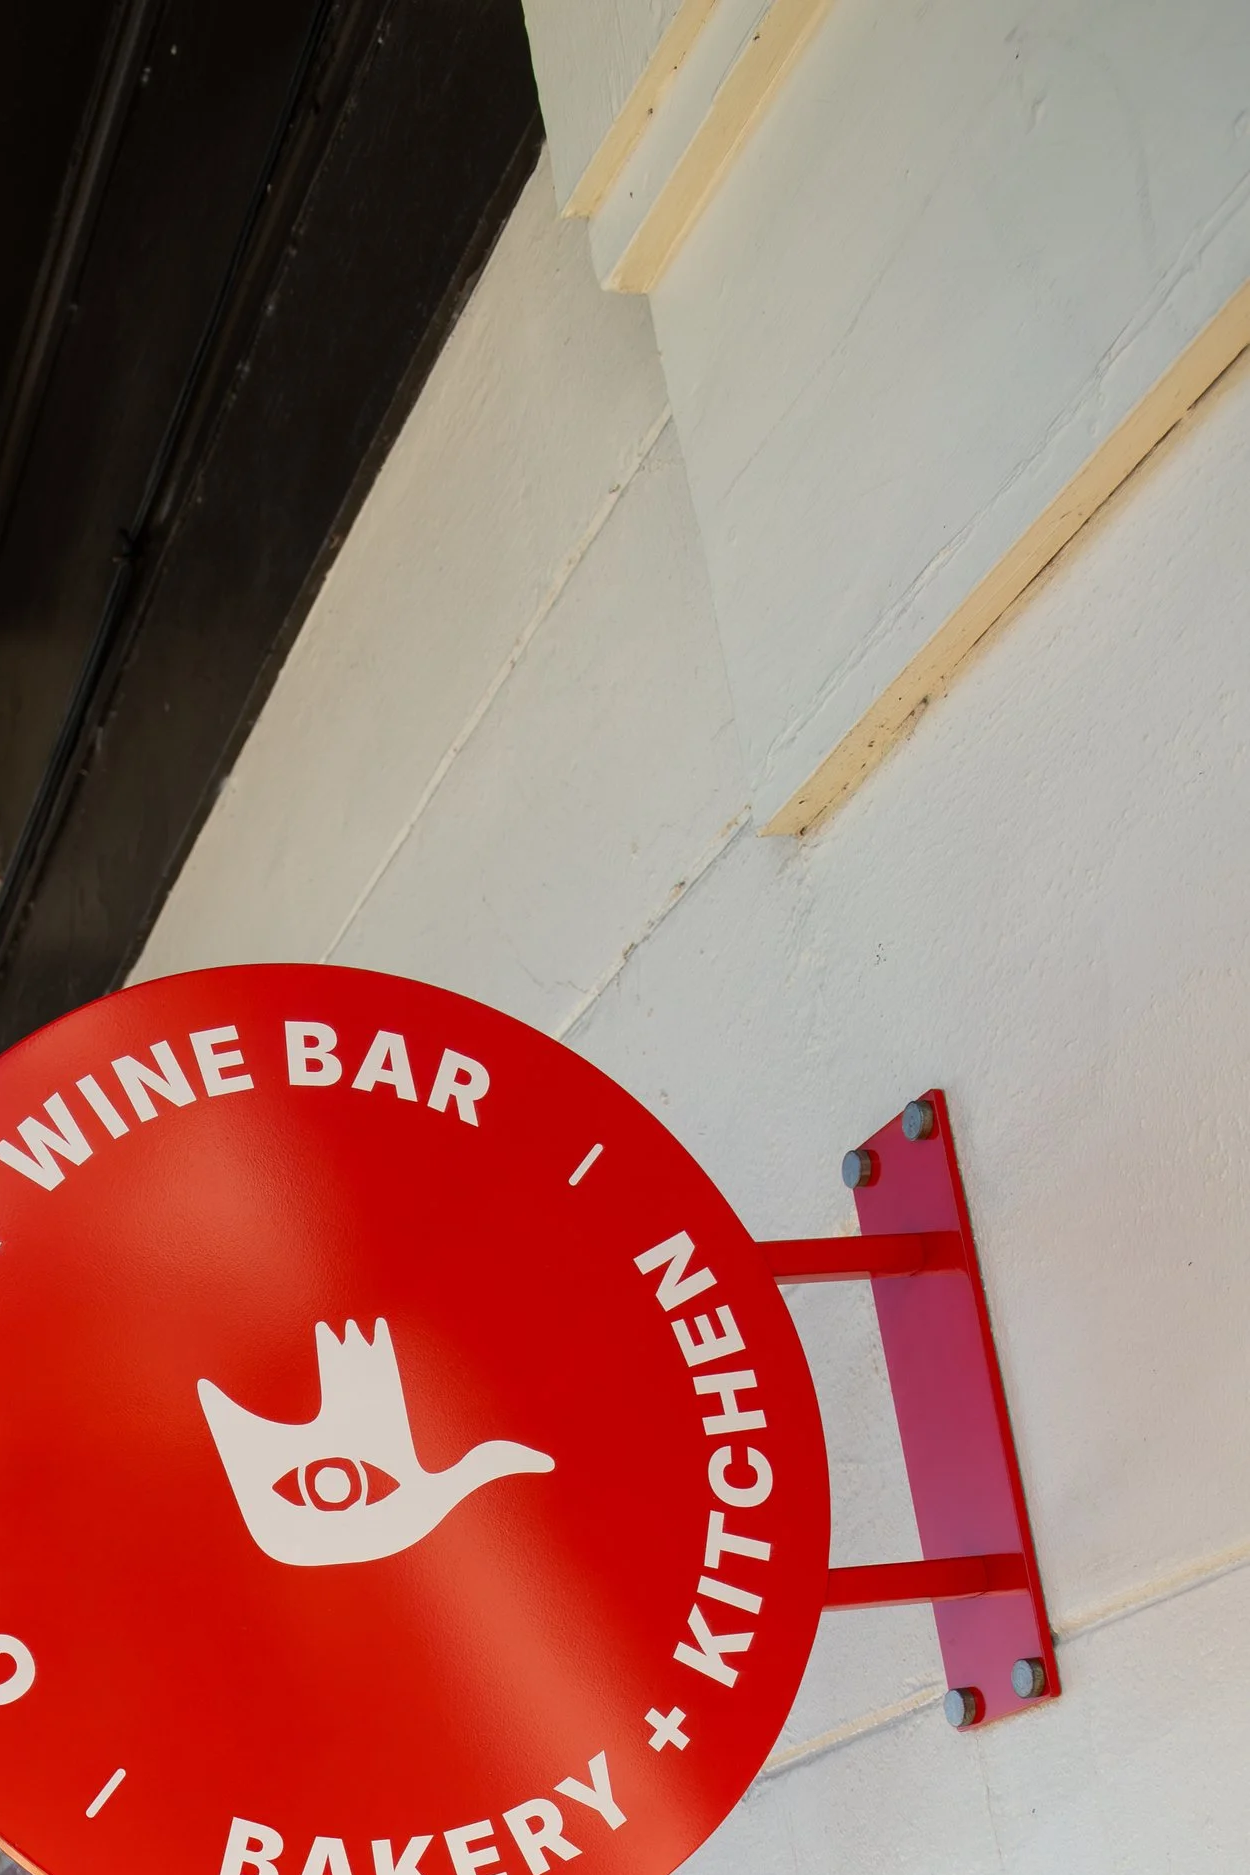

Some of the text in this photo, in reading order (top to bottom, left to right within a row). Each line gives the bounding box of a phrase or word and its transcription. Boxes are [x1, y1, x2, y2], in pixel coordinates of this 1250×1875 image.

[285, 1020, 491, 1127] BAR
[633, 1230, 774, 1689] KITCHEN
[644, 1706, 691, 1753] +
